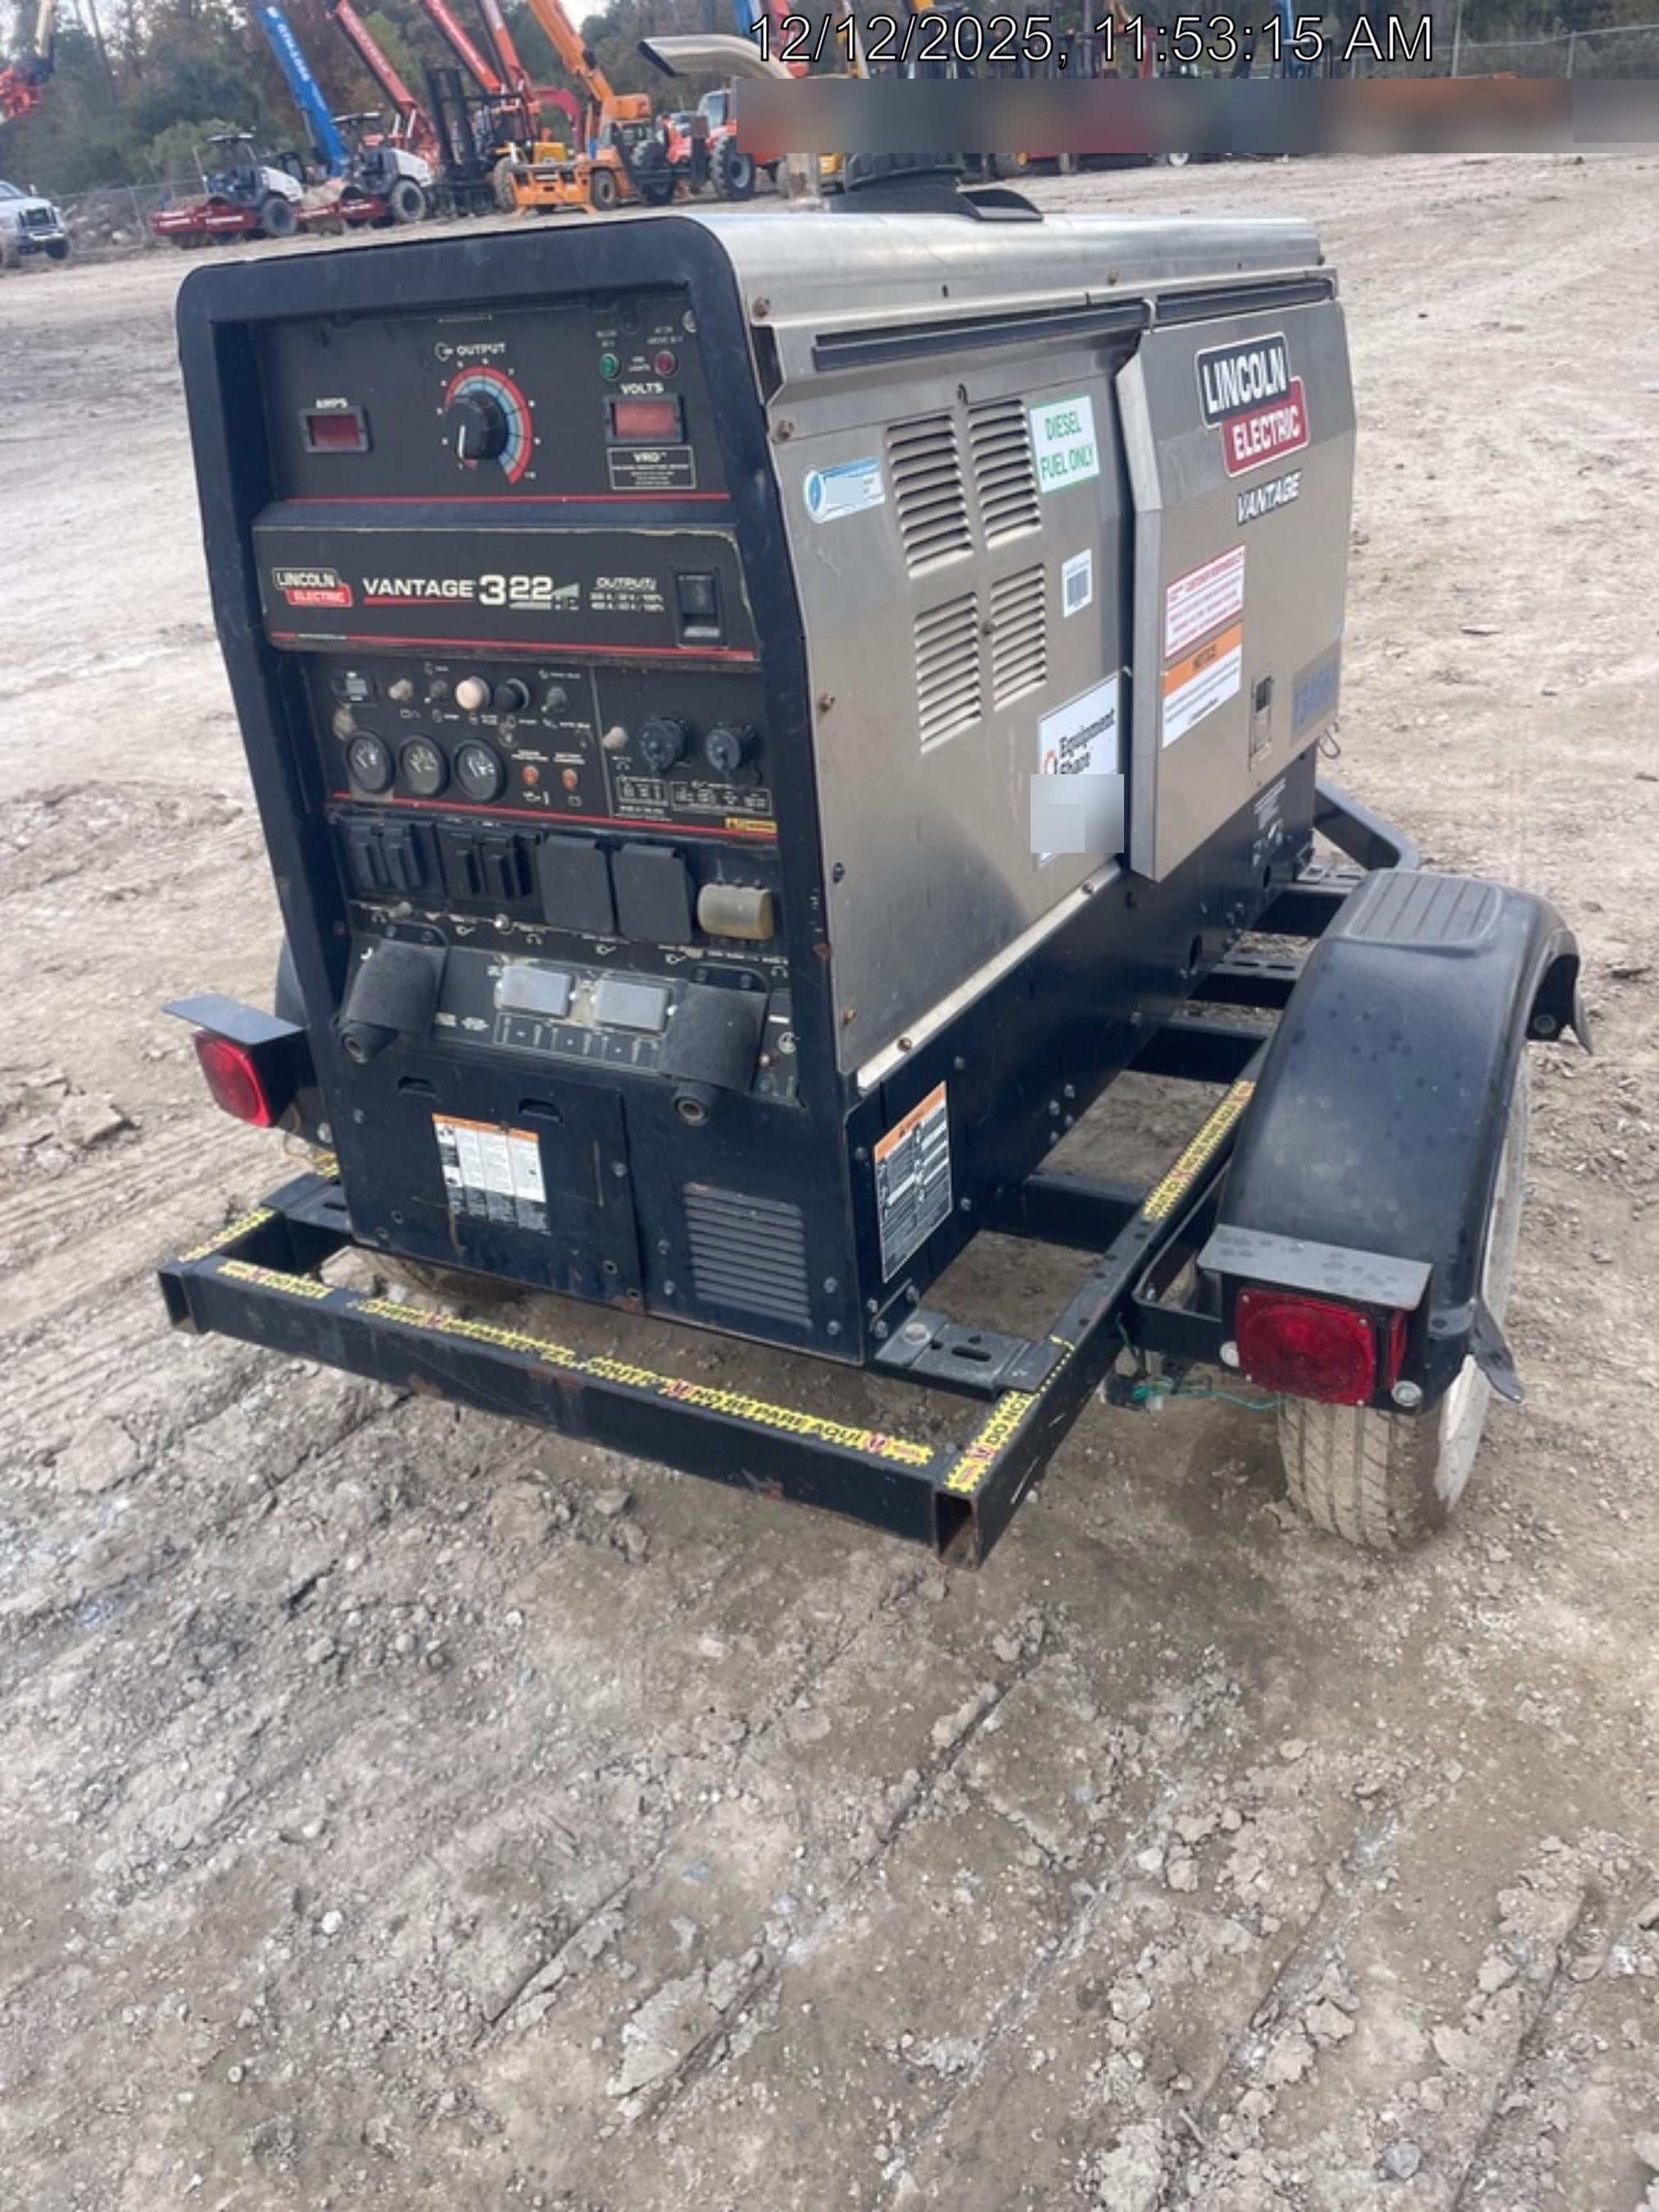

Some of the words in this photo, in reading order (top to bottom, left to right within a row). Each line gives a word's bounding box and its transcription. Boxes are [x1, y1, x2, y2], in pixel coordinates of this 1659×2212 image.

[456, 342, 506, 355] OUTPUT
[620, 383, 664, 394] VOLTS
[1203, 347, 1287, 414] LINCOLN
[1045, 412, 1082, 440] DIESEL
[1232, 405, 1301, 460] ELECTRIC
[1040, 451, 1067, 478] FUEL
[1069, 444, 1095, 470] ONLY
[1236, 467, 1303, 526] VANTAGE
[276, 573, 336, 588] LINCOLN
[362, 578, 474, 598] VANTAGE
[478, 574, 553, 606] 322
[293, 592, 345, 604] ELECTRIC
[1059, 708, 1115, 758] Equipment
[985, 1423, 1009, 1445] DO
